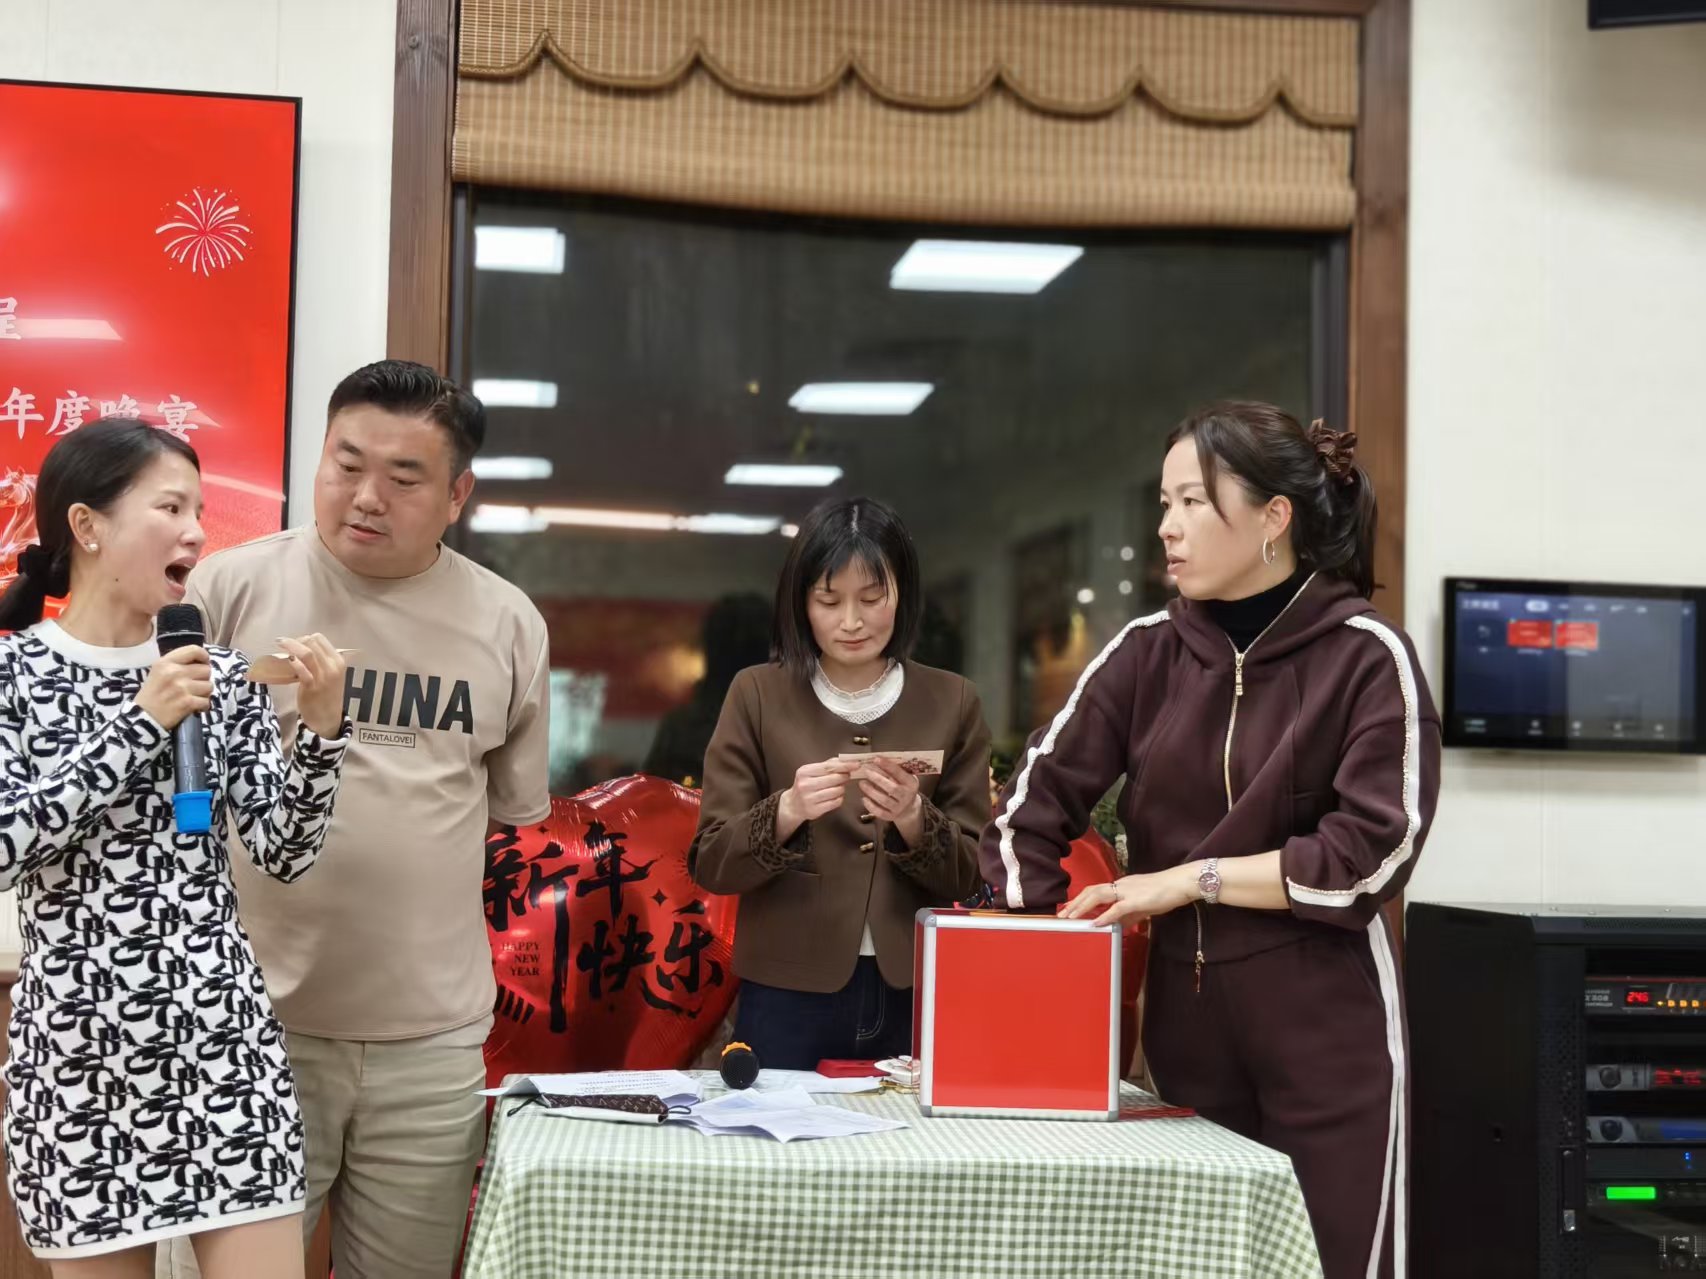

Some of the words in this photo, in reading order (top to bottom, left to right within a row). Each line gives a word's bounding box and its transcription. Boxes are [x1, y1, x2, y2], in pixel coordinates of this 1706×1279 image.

[342, 666, 474, 735] HINA
[483, 821, 664, 1034] 新年
[514, 953, 540, 963] NEW
[576, 899, 725, 1020] 快乐
[510, 966, 540, 977] YEAR
